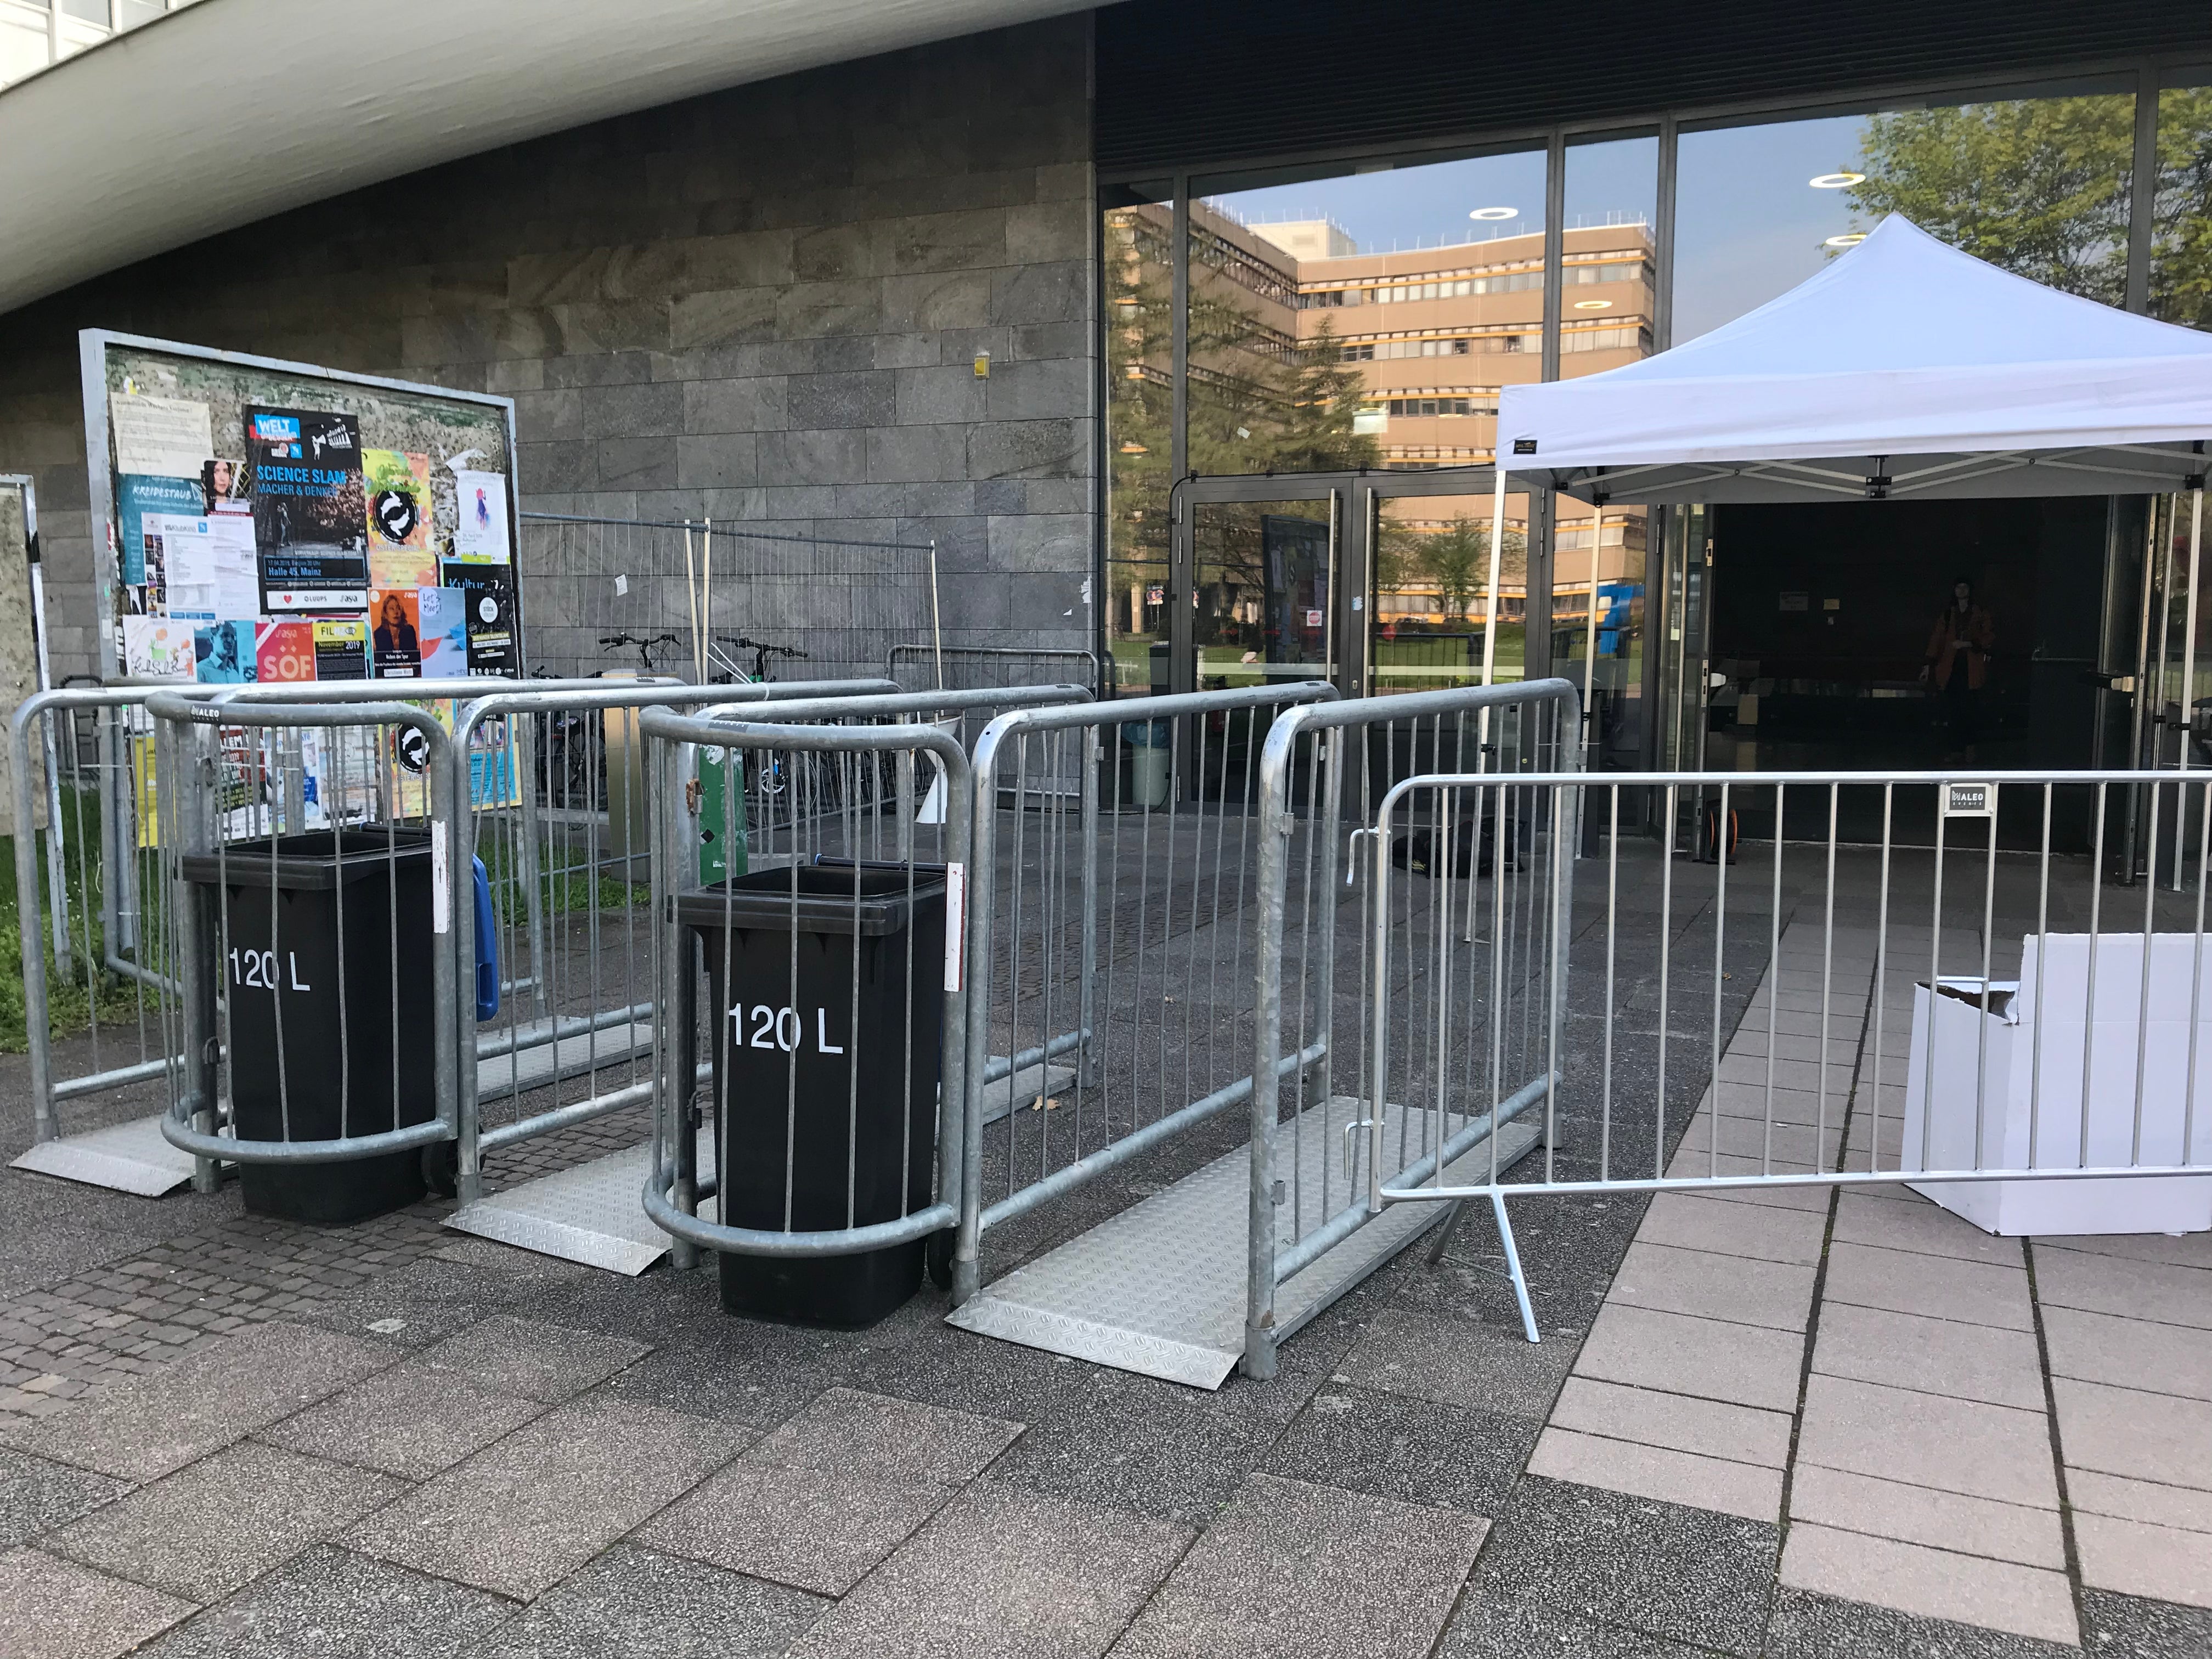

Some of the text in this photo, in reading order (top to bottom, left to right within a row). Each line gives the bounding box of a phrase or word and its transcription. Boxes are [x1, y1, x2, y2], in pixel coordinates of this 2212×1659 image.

[258, 420, 290, 432] WELT
[257, 465, 347, 485] SCIENCE SLAM
[258, 483, 294, 495] MACHER
[296, 485, 303, 495] &
[269, 567, 287, 576] Halle
[301, 567, 321, 576] Mainz
[449, 578, 485, 590] Kultur
[345, 641, 360, 650] 2019
[1951, 790, 1984, 801] MALEO
[229, 947, 311, 991] 120 L
[729, 1003, 843, 1054] 120 L
